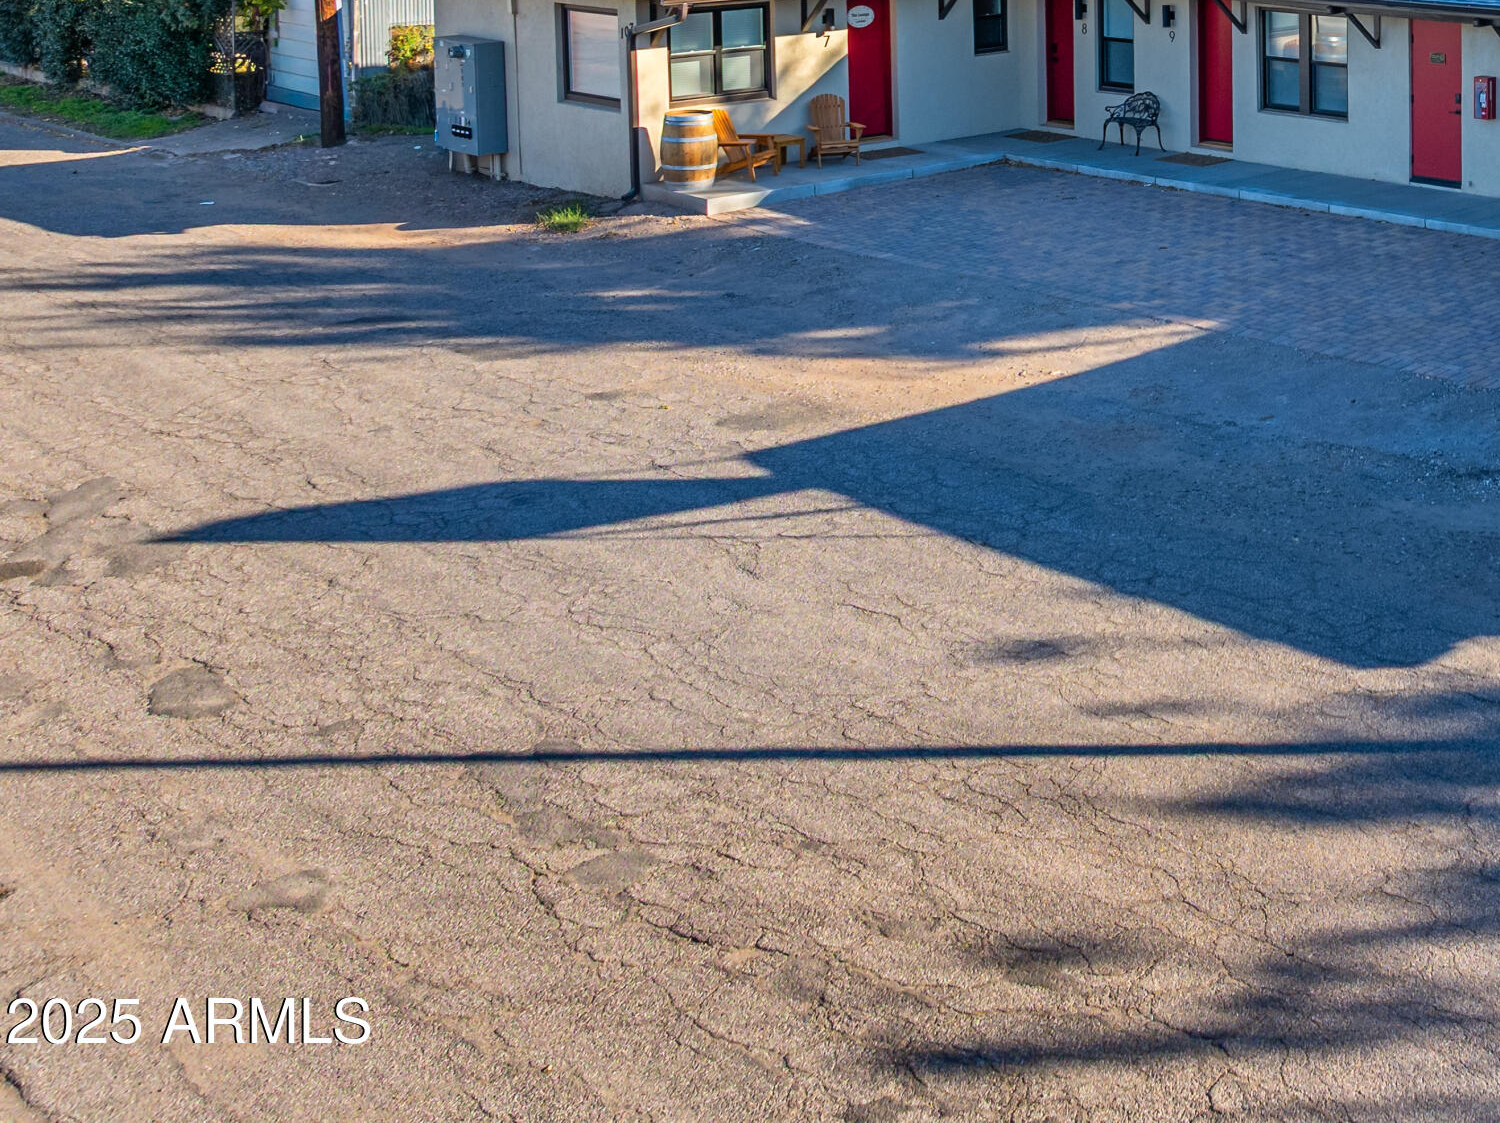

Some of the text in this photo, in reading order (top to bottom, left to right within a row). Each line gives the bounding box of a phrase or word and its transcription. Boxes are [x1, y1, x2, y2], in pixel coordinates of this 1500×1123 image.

[1081, 23, 1088, 35] 8
[823, 35, 830, 48] 7
[1169, 30, 1176, 43] 9
